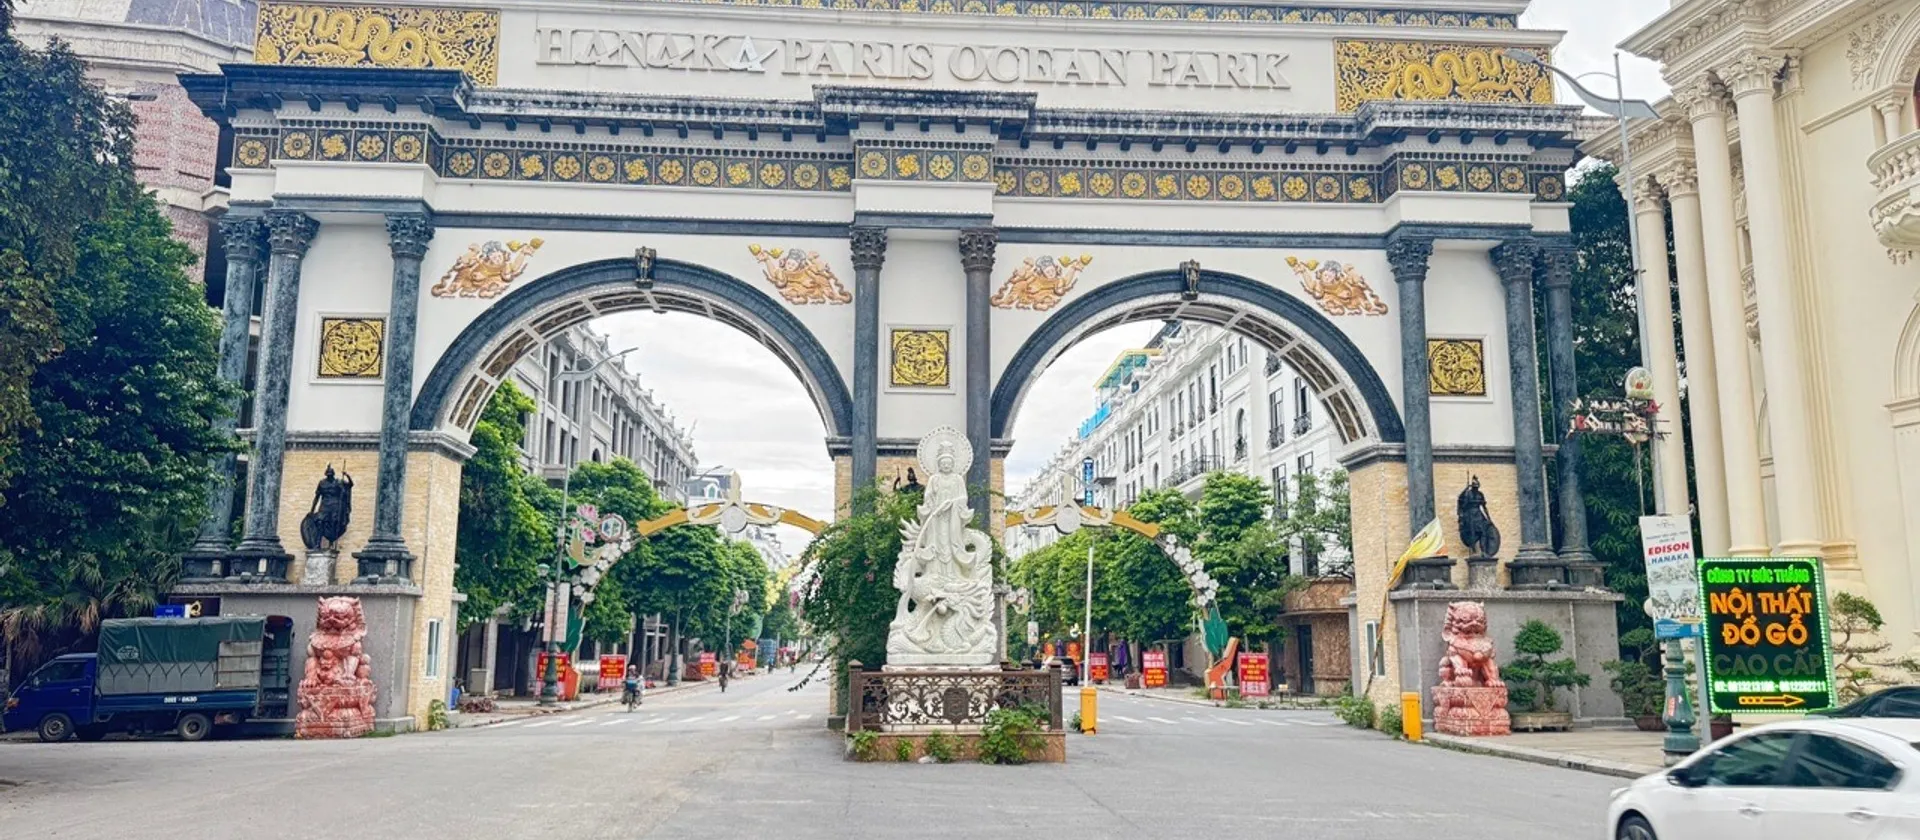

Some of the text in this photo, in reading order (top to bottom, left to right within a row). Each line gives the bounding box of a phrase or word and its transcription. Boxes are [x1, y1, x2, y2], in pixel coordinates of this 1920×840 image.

[536, 29, 1292, 90] HANAKA PARIS OCEAN PARK
[1648, 542, 1690, 557] EDISON
[1651, 552, 1689, 565] HANAKA
[1736, 568, 1750, 583] TY
[1710, 584, 1813, 619] NỘI THẤT
[1765, 613, 1808, 645] GỖ
[1714, 647, 1823, 676] CAO CẤP
